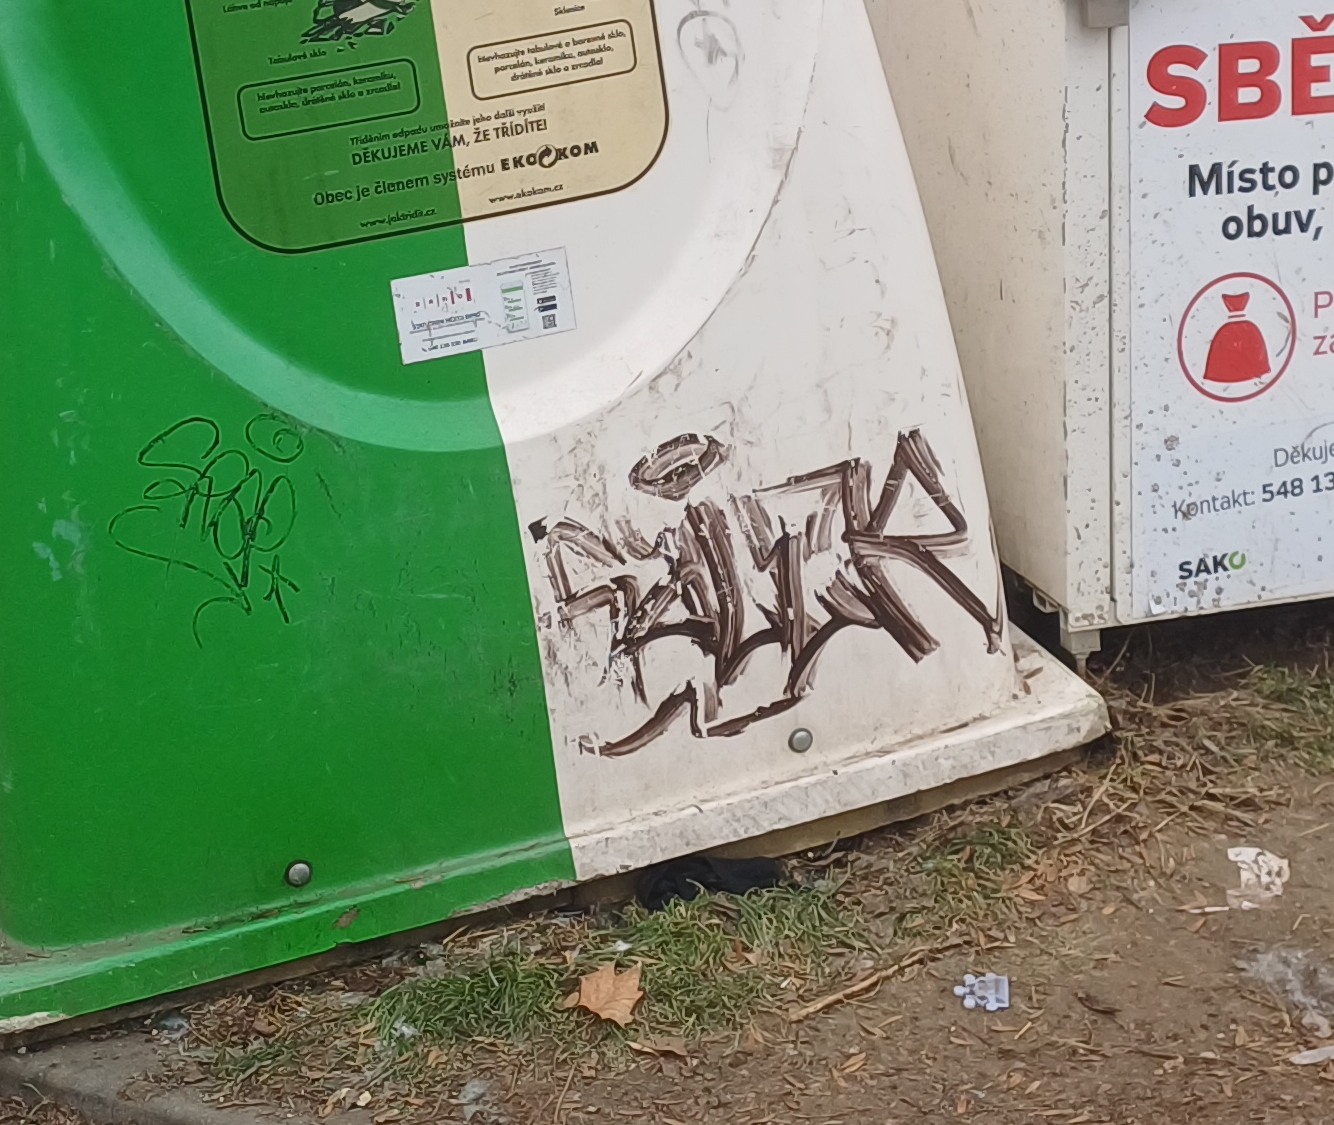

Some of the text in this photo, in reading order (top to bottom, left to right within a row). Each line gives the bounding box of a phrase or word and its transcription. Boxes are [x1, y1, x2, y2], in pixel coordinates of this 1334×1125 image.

[352, 118, 547, 165] DĚKUJEME VÁM, ŽE TŘÍDÍTE!
[314, 189, 353, 205] Obec
[356, 185, 370, 202] je
[375, 176, 429, 194] členem
[433, 164, 495, 185] systému
[1187, 156, 1300, 199] Místo
[1221, 205, 1322, 242] obuv,
[1171, 488, 1256, 521] Kontakt:
[1261, 478, 1304, 503] 548
[1178, 549, 1246, 581] SAKO
